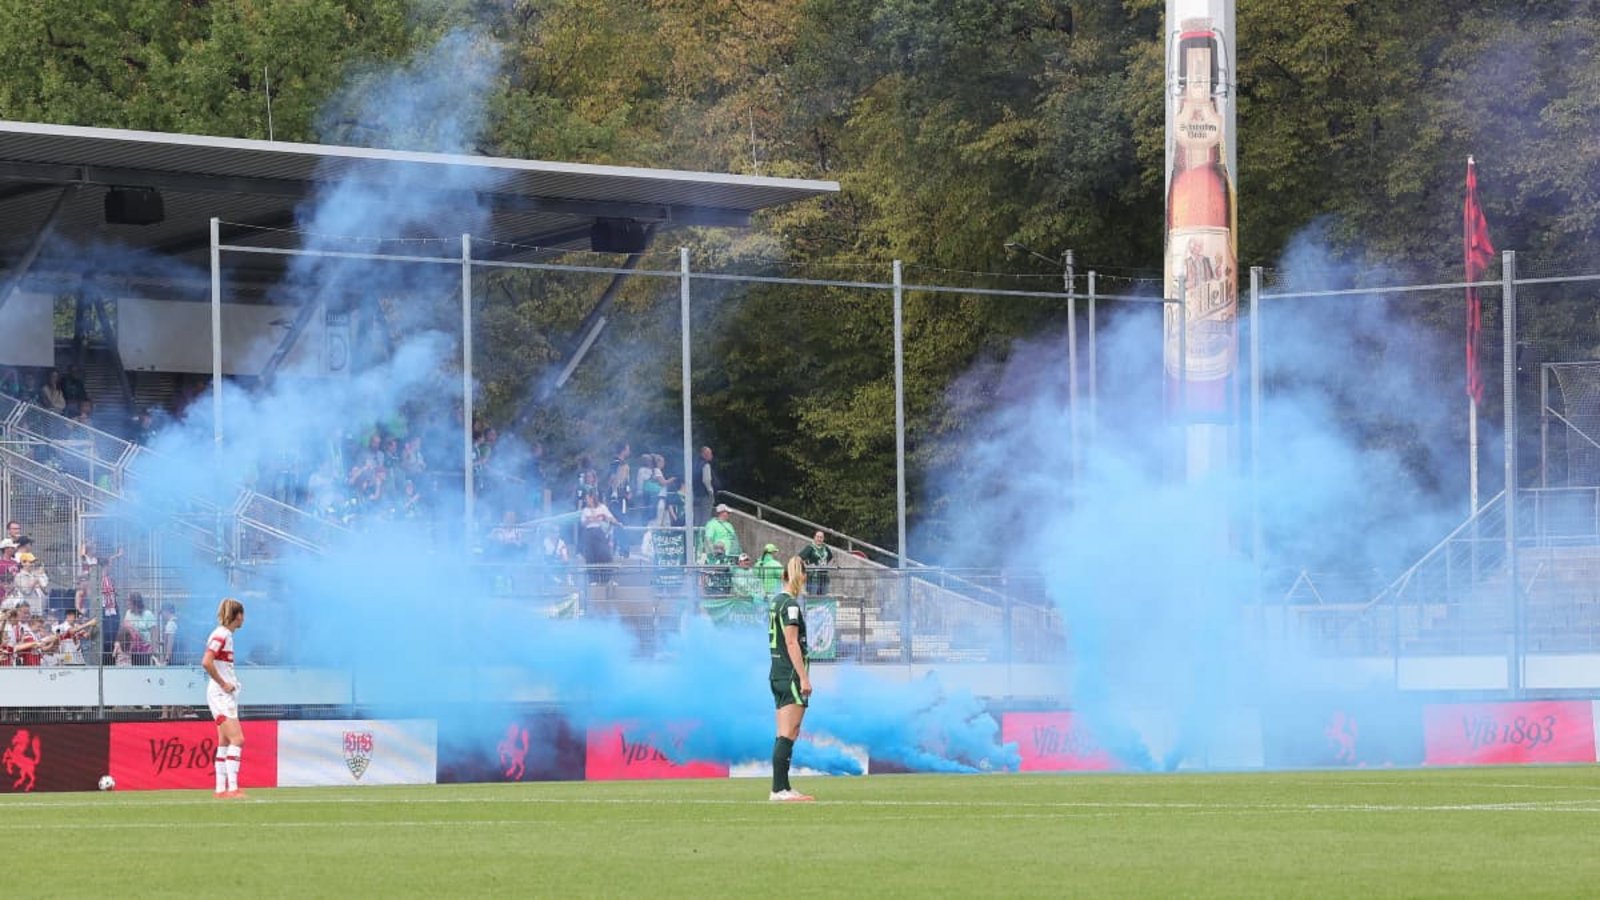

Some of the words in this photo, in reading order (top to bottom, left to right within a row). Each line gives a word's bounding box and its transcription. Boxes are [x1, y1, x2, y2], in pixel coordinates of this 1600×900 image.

[1463, 714, 1498, 751] VfB
[1502, 715, 1555, 749] 1893
[151, 737, 184, 776] VfB
